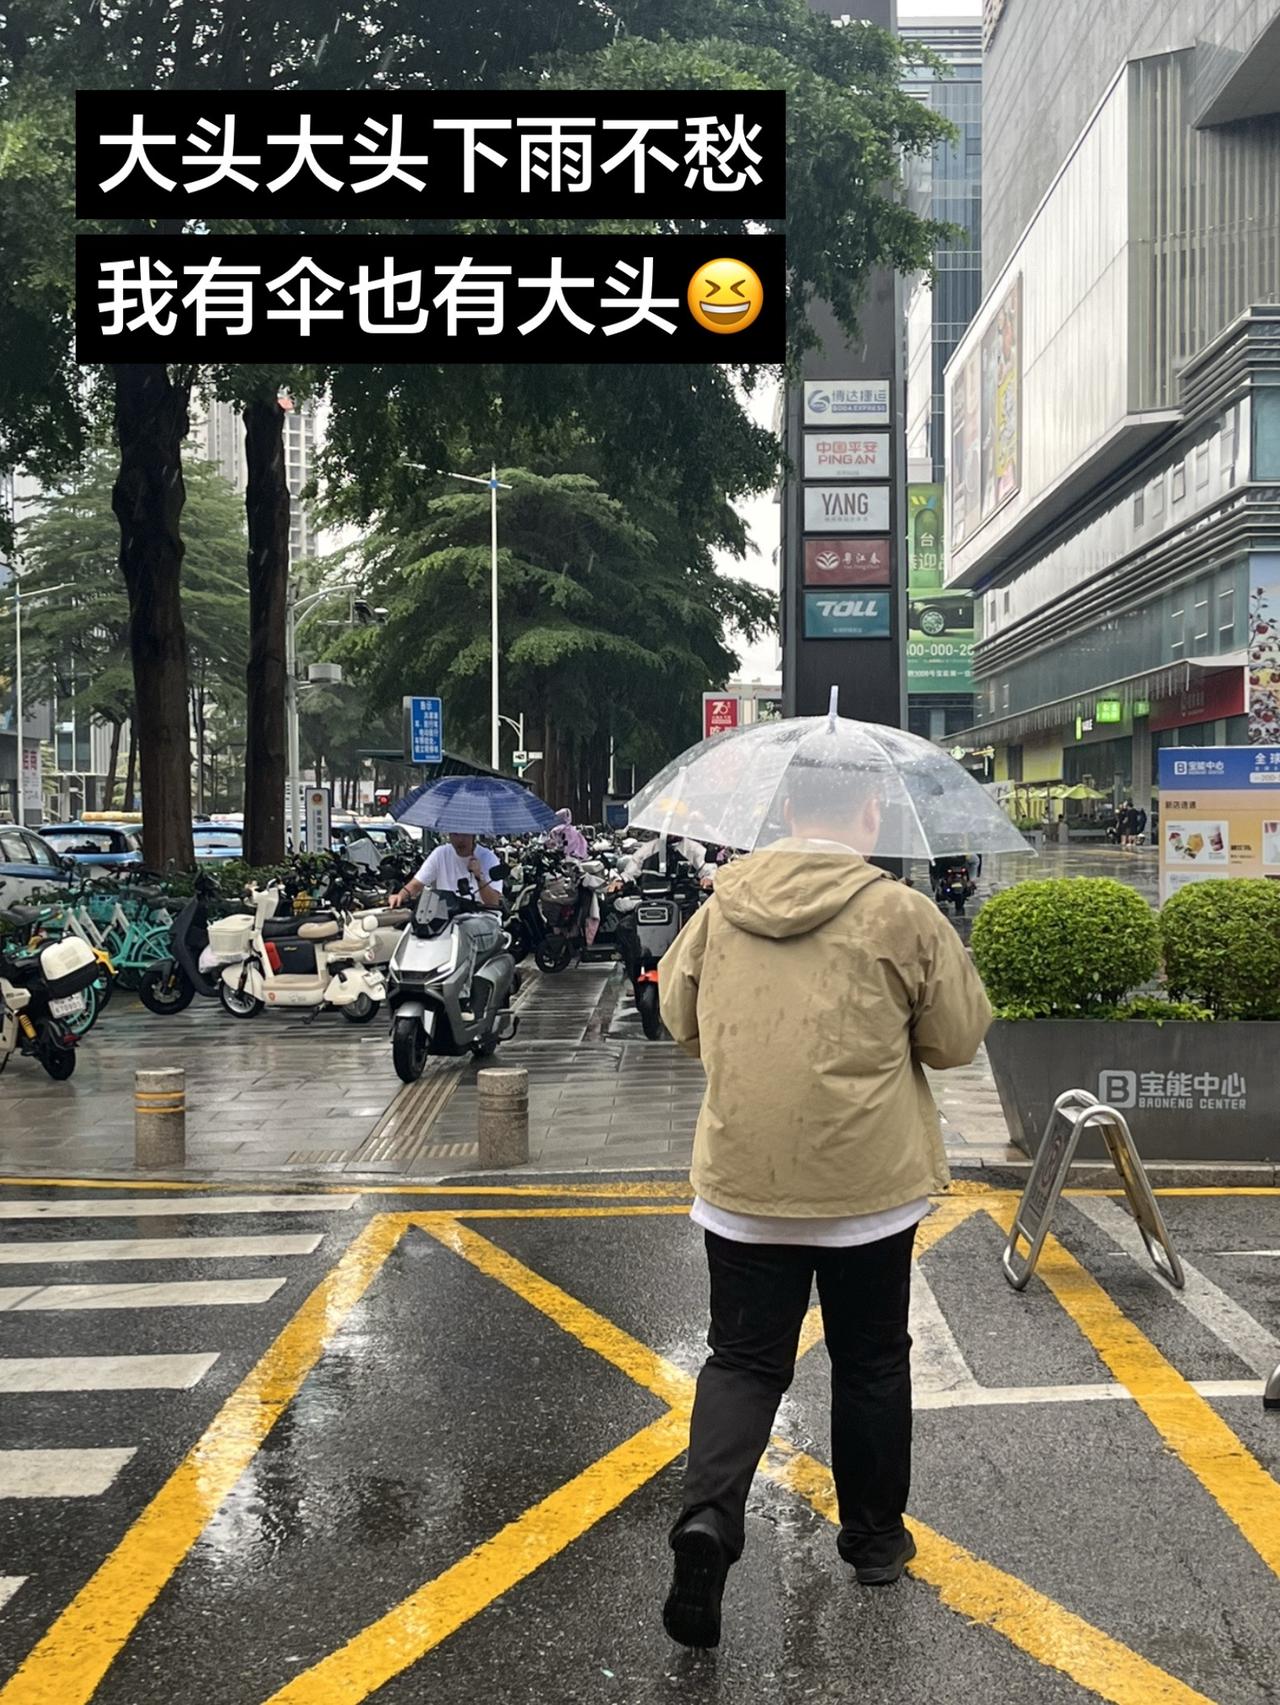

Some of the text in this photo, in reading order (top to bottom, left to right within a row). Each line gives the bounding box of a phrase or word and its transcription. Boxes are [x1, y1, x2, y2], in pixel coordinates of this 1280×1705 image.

[816, 441, 878, 453] 中国平安
[821, 493, 868, 515] YANG
[816, 601, 878, 617] TOLL
[1139, 1071, 1247, 1097] 宝能中心
[1138, 1097, 1247, 1110] BAONENG CENTER
